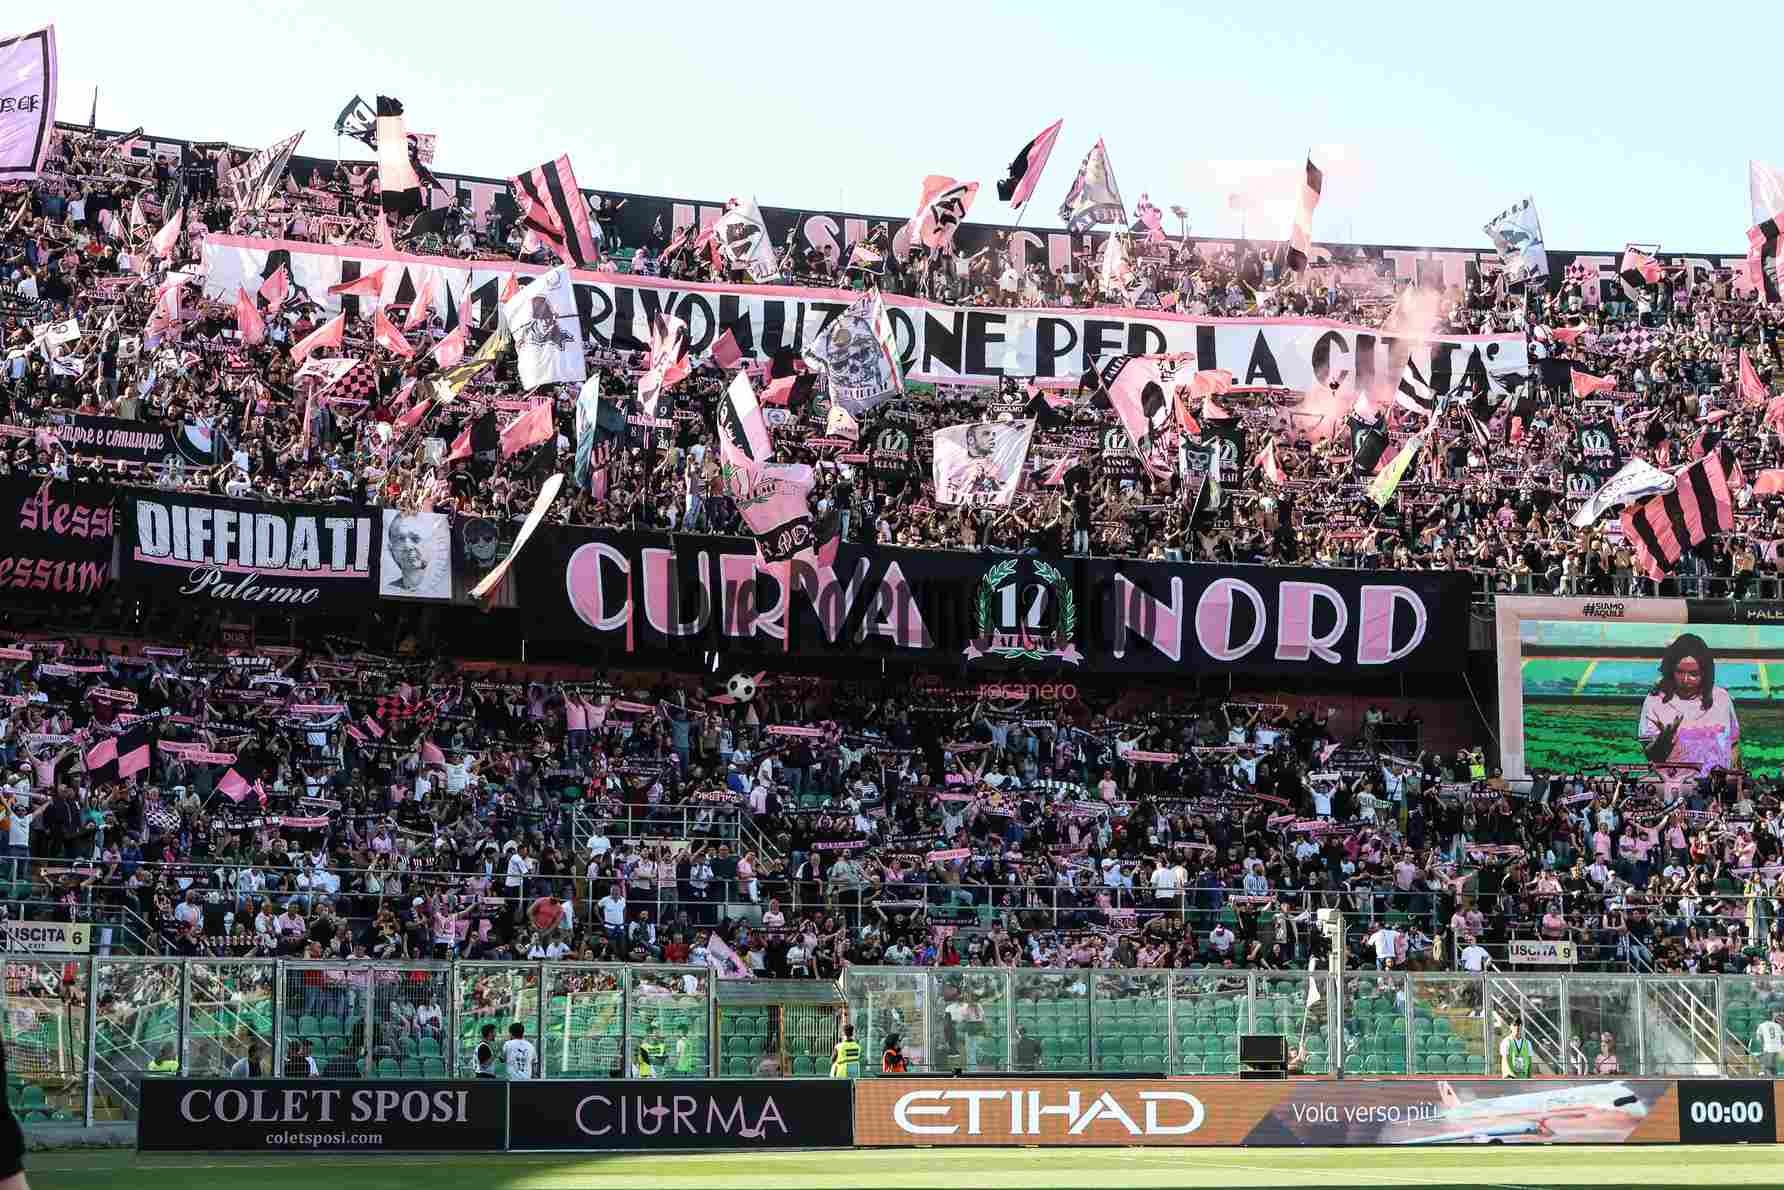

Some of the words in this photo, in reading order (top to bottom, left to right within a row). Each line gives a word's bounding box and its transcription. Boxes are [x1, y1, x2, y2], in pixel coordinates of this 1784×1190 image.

[1196, 324, 1285, 386] LA
[53, 423, 96, 447] empre
[96, 431, 105, 445] e
[105, 431, 165, 456] comunque
[136, 499, 371, 571] DIFFIDATI
[178, 564, 320, 605] Palermo
[566, 541, 936, 648] CURVA
[996, 582, 1053, 628] 12
[1113, 577, 1428, 664] NORD
[9, 927, 66, 942] USCITA
[72, 931, 82, 944] 6
[180, 1089, 341, 1122] COLET
[351, 1090, 469, 1122] SPOSI
[575, 1095, 789, 1138] CIURMA
[893, 1090, 1206, 1135] ETIHAD
[1292, 1103, 1338, 1123] Vola
[1342, 1107, 1399, 1123] verso
[1689, 1101, 1764, 1123] 00:00
[265, 1131, 383, 1147] coletsposi.com
